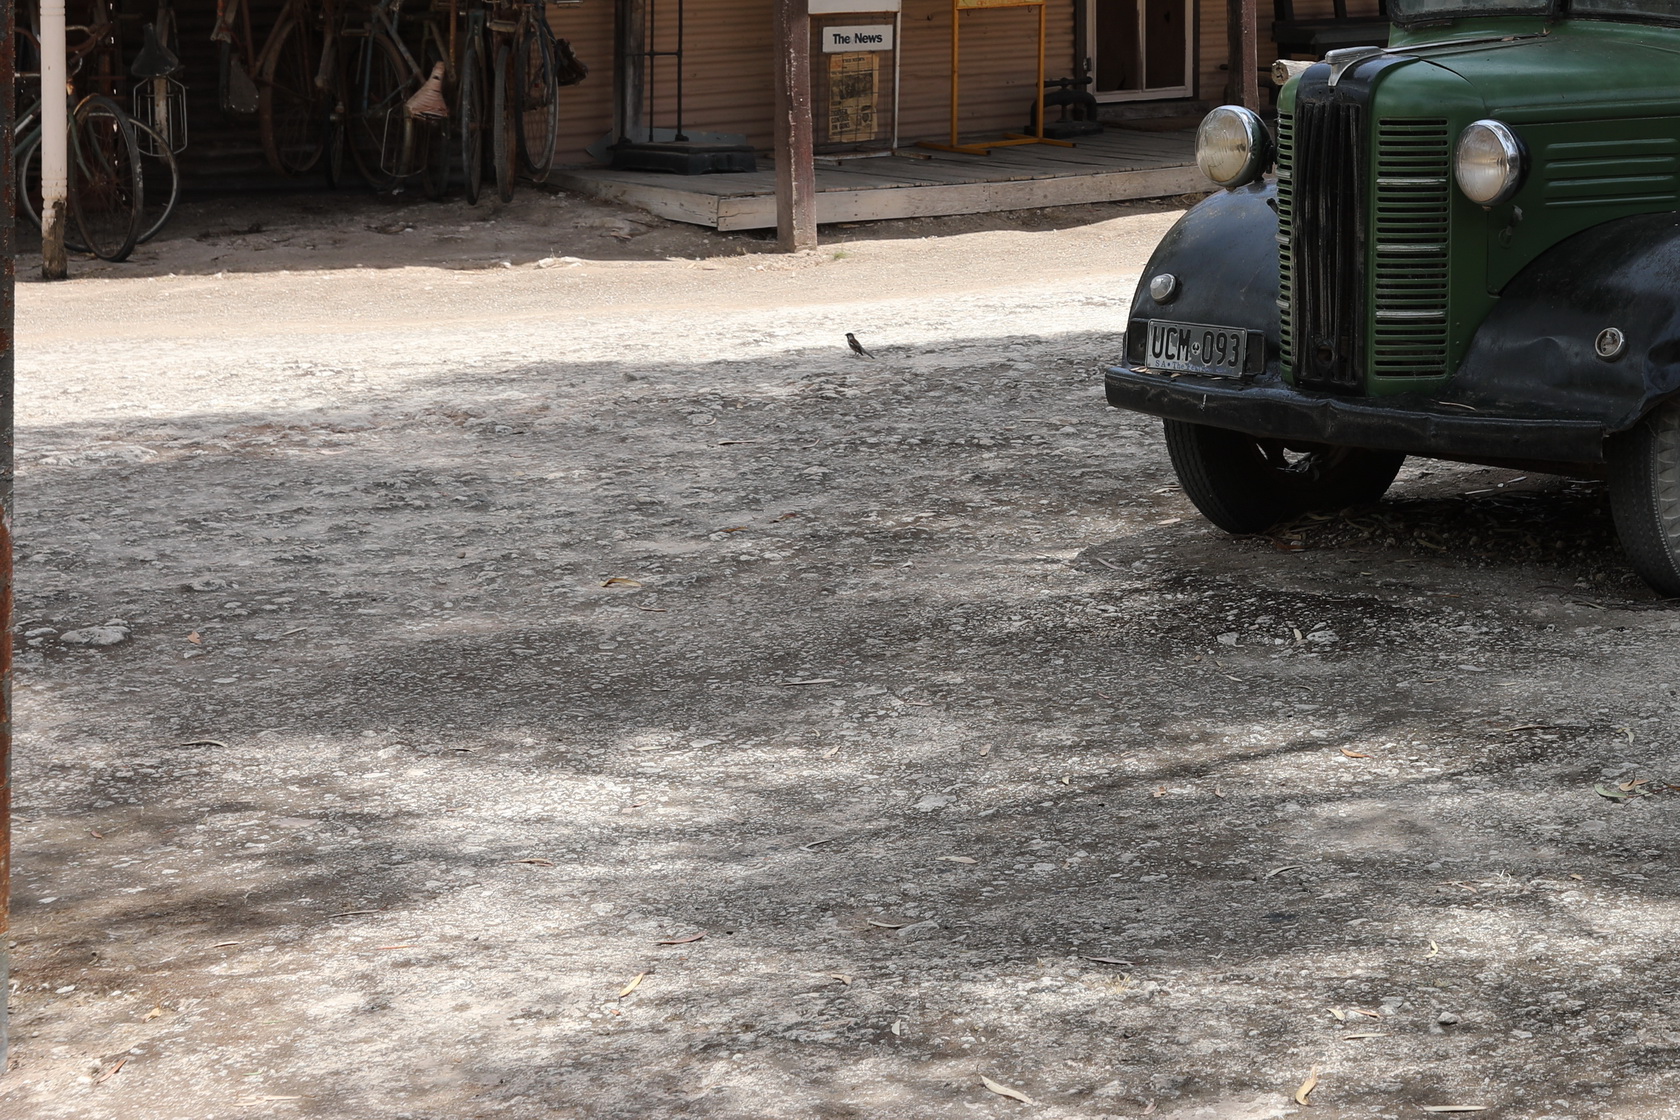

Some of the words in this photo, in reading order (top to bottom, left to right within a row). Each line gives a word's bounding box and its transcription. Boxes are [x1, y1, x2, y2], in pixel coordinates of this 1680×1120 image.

[833, 33, 851, 45] The
[854, 32, 883, 44] News
[1152, 325, 1192, 362] UCM
[1201, 330, 1240, 368] 093
